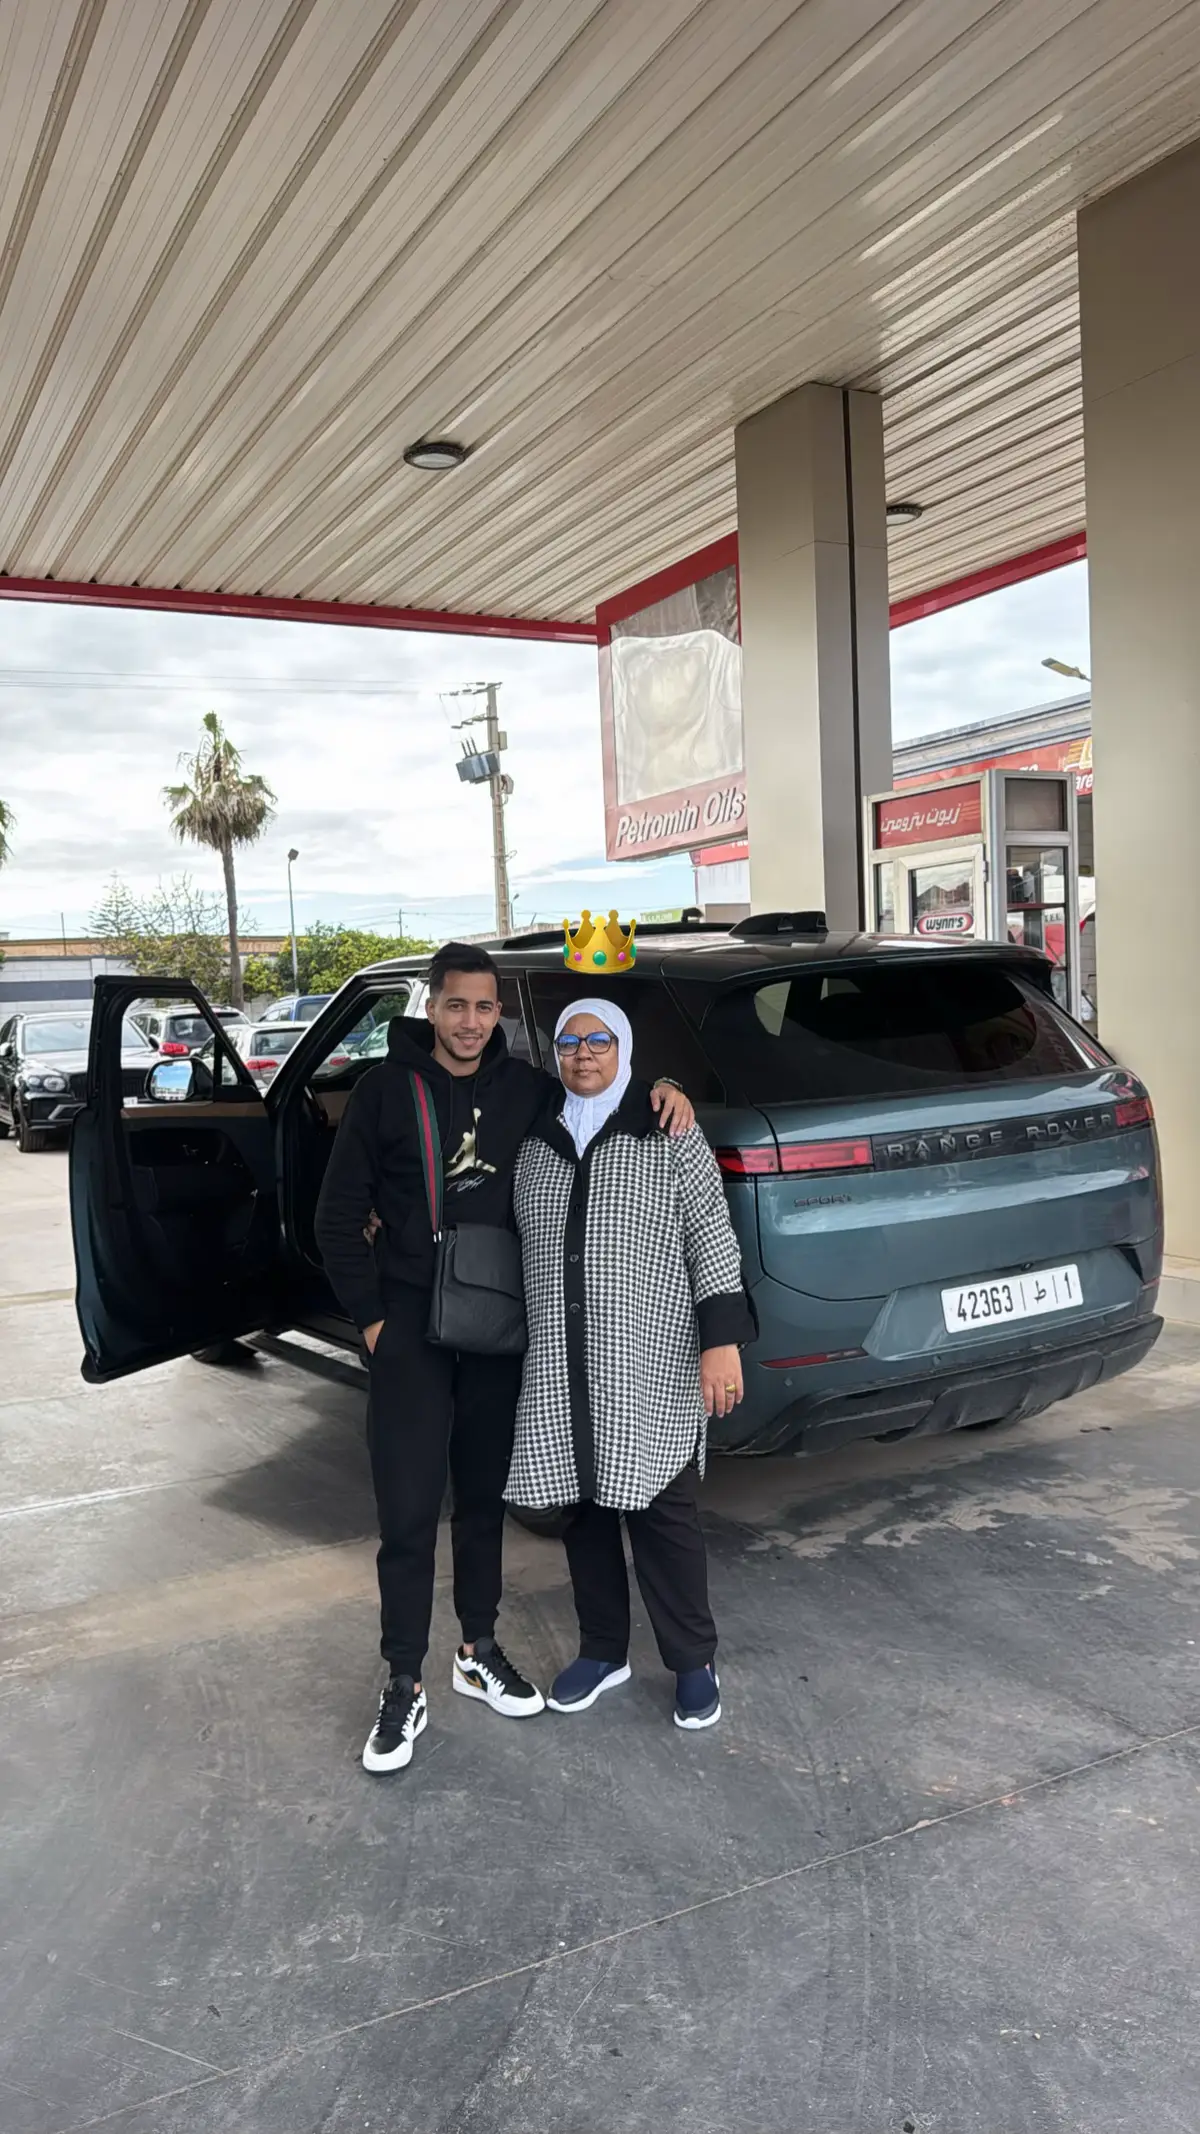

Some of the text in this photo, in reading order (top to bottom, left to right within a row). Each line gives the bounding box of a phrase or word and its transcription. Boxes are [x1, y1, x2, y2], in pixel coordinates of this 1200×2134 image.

[616, 787, 746, 848] Petromin Oils
[880, 803, 961, 835] زيوت بترومين
[887, 1113, 1112, 1158] RANGE ROVER
[957, 1284, 1014, 1321] 42363
[1064, 1272, 1073, 1299] 1
